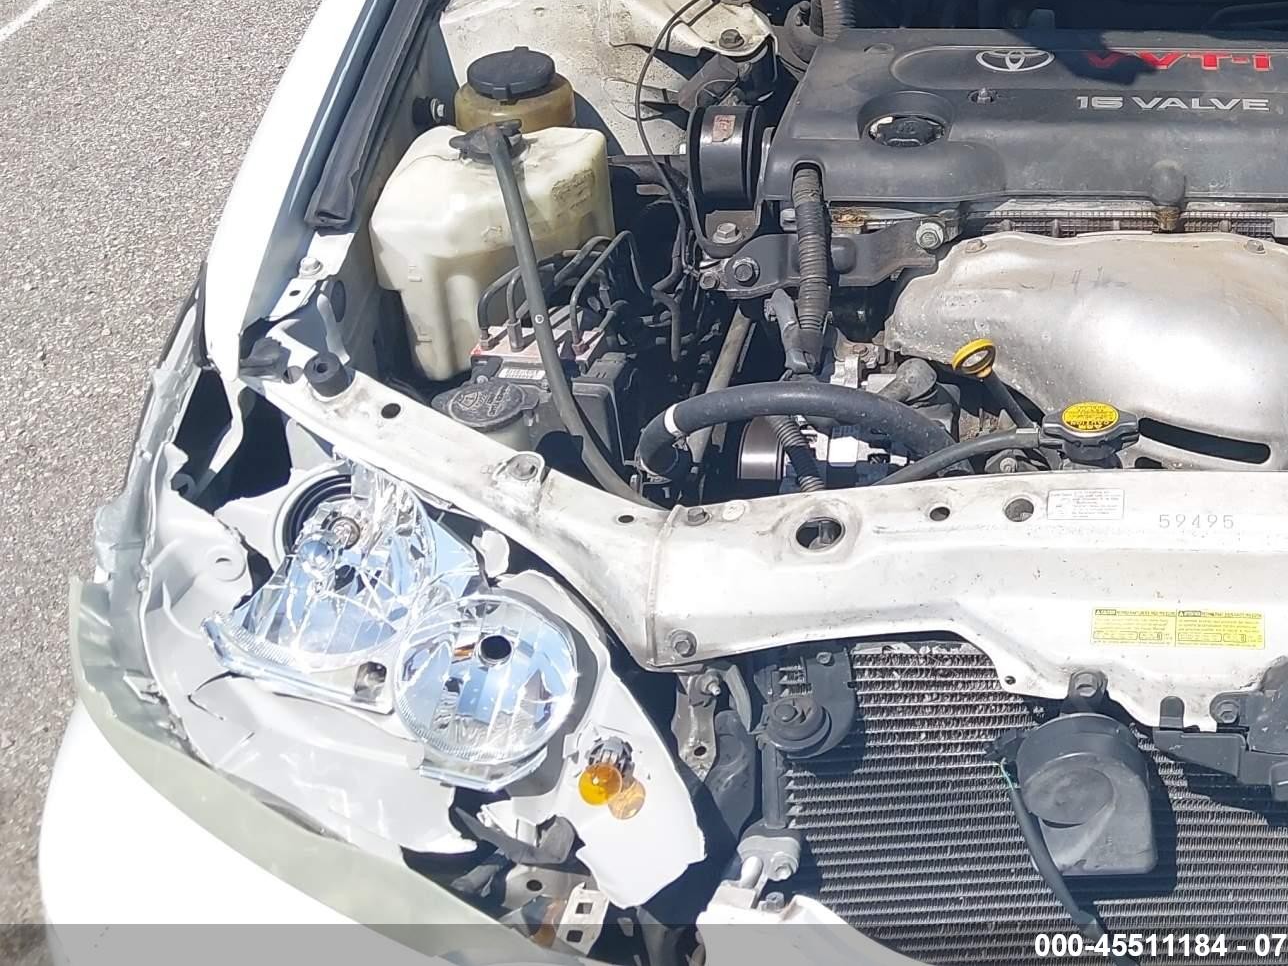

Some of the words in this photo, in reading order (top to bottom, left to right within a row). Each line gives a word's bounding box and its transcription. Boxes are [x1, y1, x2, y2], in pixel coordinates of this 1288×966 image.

[1077, 96, 1124, 110] 16
[1132, 97, 1270, 112] VALVE
[1158, 513, 1235, 530] 59495
